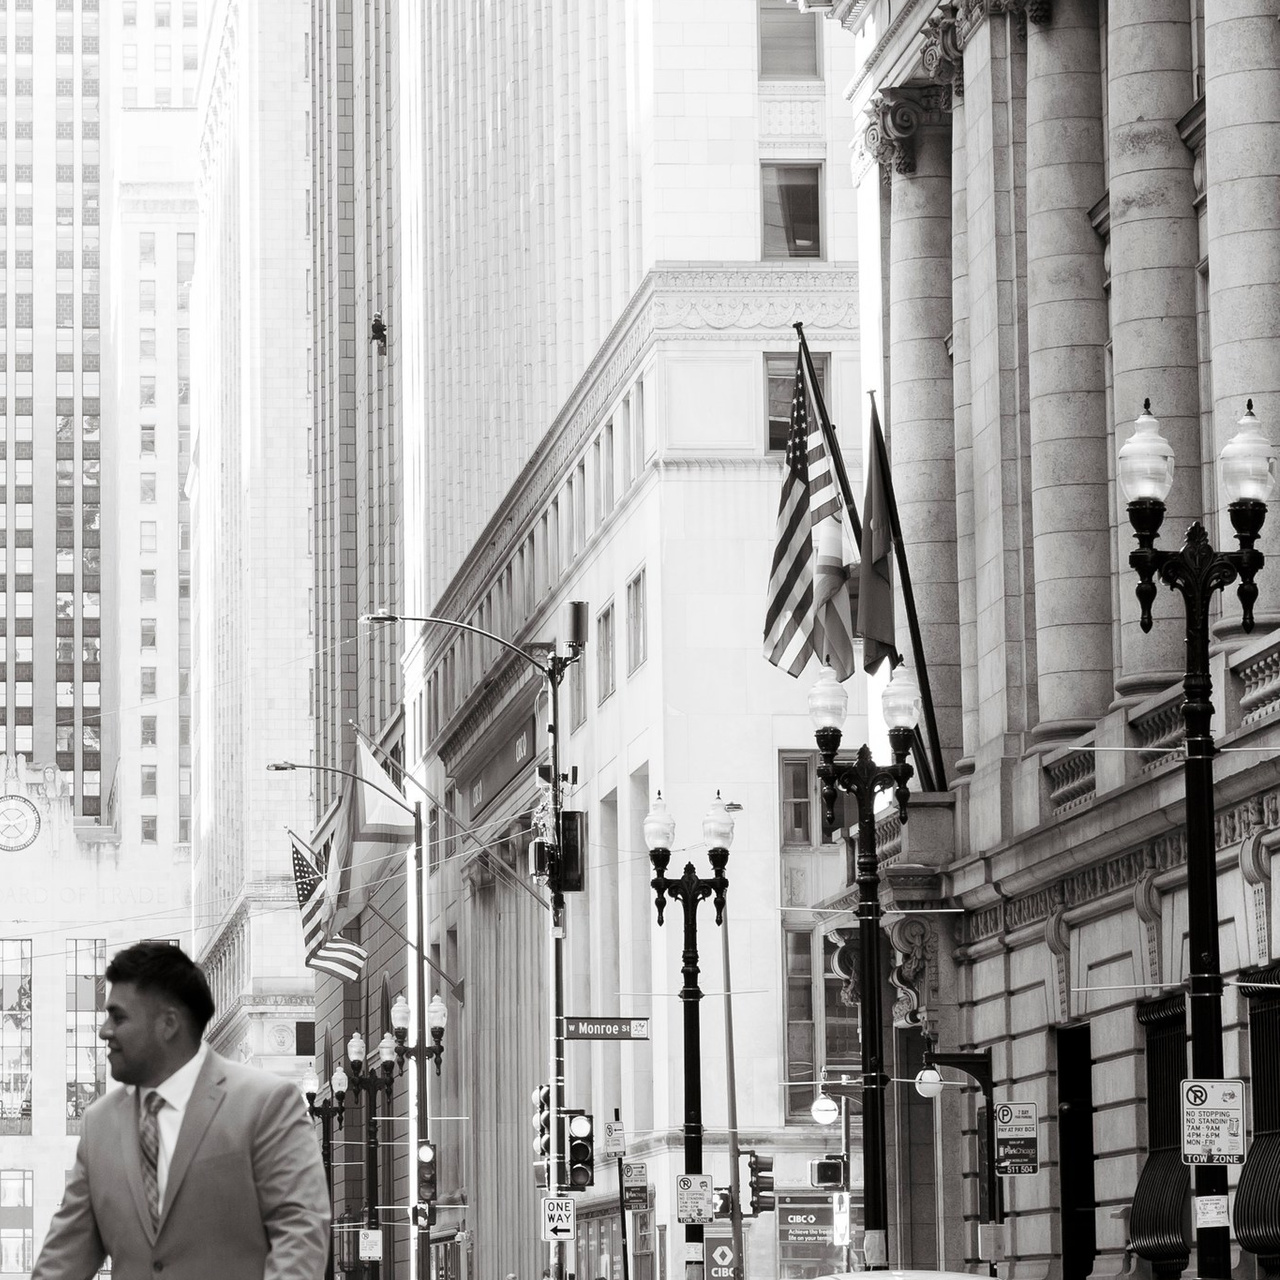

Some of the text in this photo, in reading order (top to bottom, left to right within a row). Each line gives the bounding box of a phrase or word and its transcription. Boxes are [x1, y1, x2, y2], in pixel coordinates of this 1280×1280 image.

[60, 886, 88, 905] OF
[97, 886, 168, 905] TRADE
[579, 1022, 619, 1034] Monroe
[548, 1202, 571, 1212] ONE
[548, 1214, 571, 1223] WAY
[711, 1268, 734, 1277] CIBC
